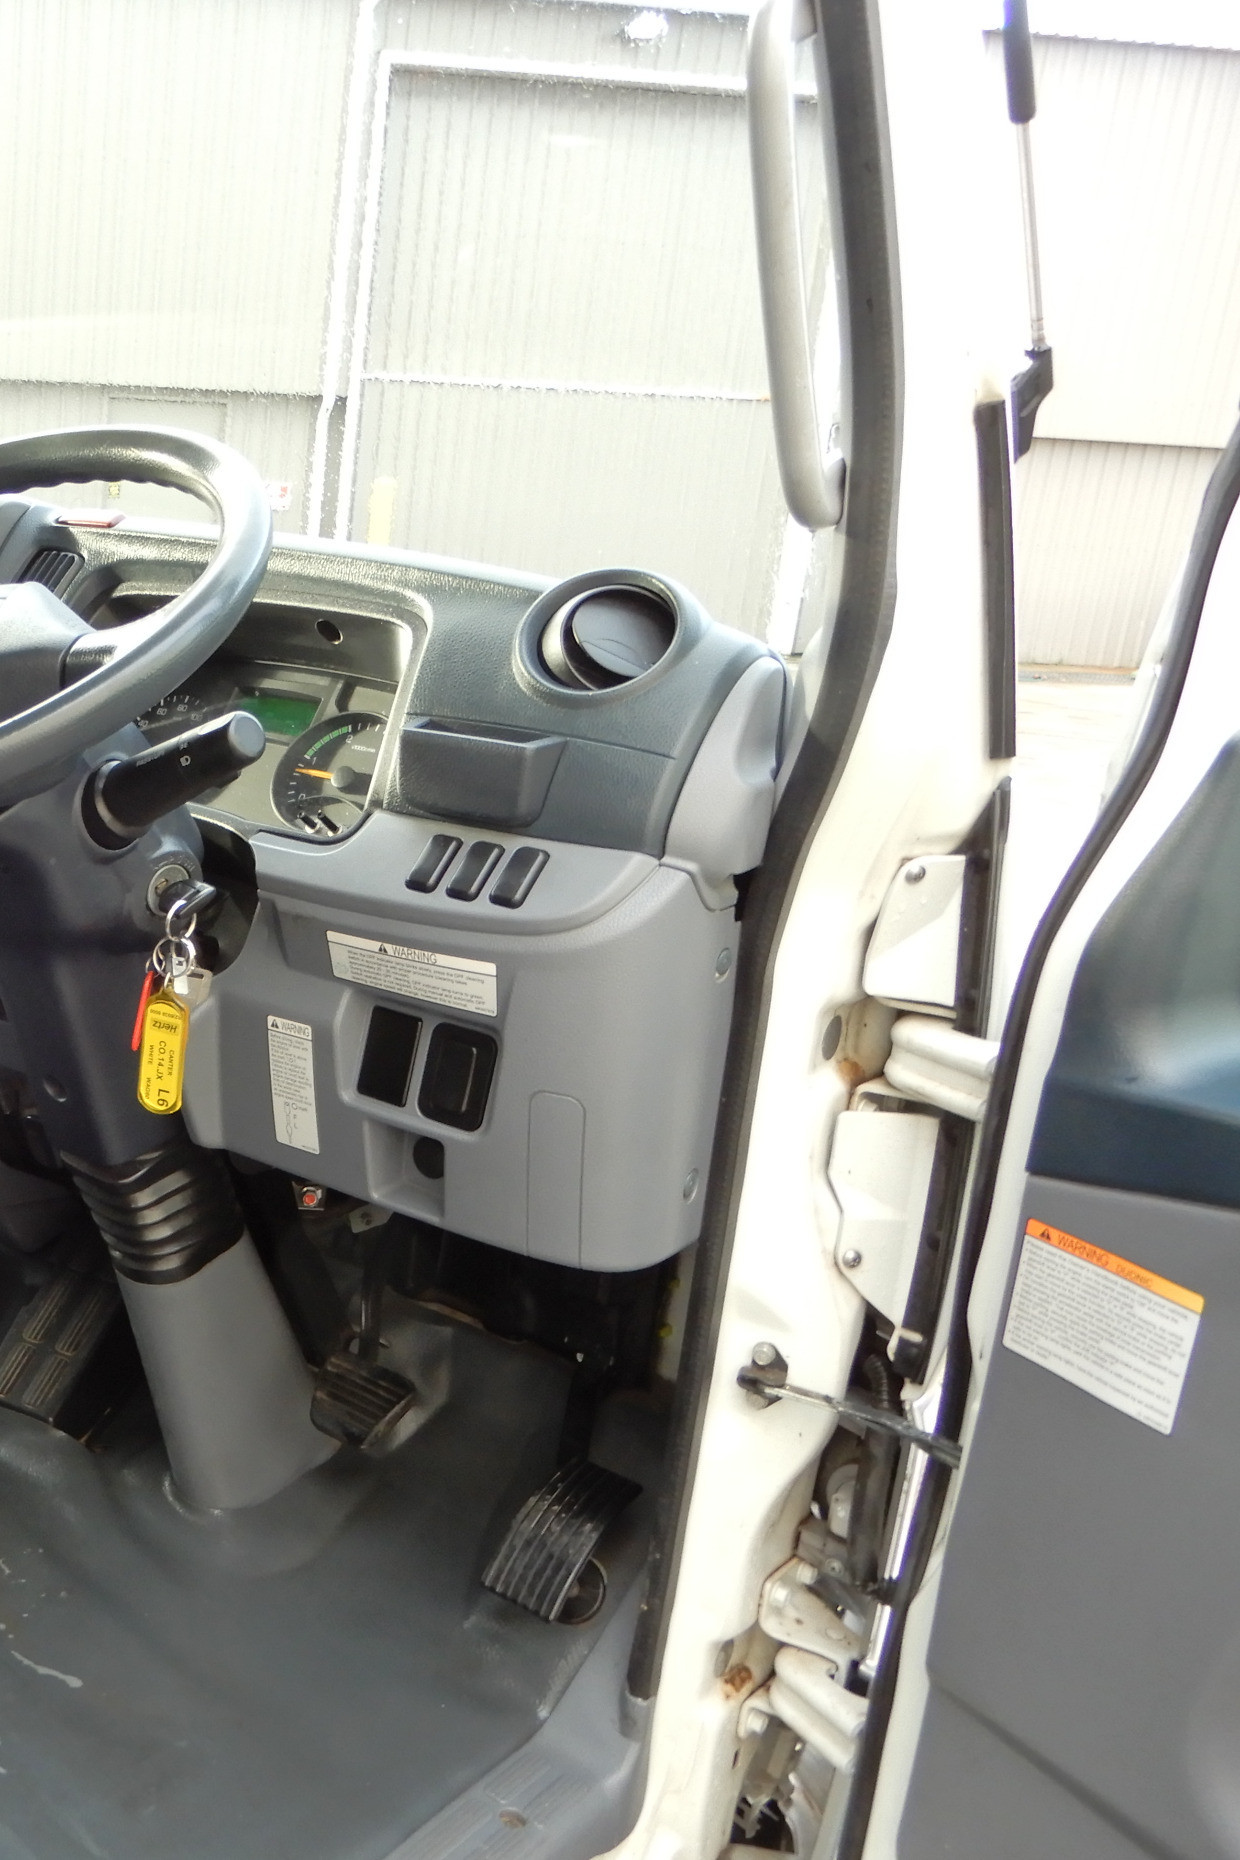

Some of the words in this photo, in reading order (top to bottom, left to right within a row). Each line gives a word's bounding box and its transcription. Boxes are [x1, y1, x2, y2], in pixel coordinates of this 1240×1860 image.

[345, 735, 354, 743] 2
[391, 945, 438, 965] WARNING
[152, 1020, 178, 1033] Hertz
[280, 1021, 311, 1038] WARNING
[167, 1049, 175, 1077] CANTER
[157, 1088, 170, 1108] L6
[1056, 1233, 1110, 1268] WARNING
